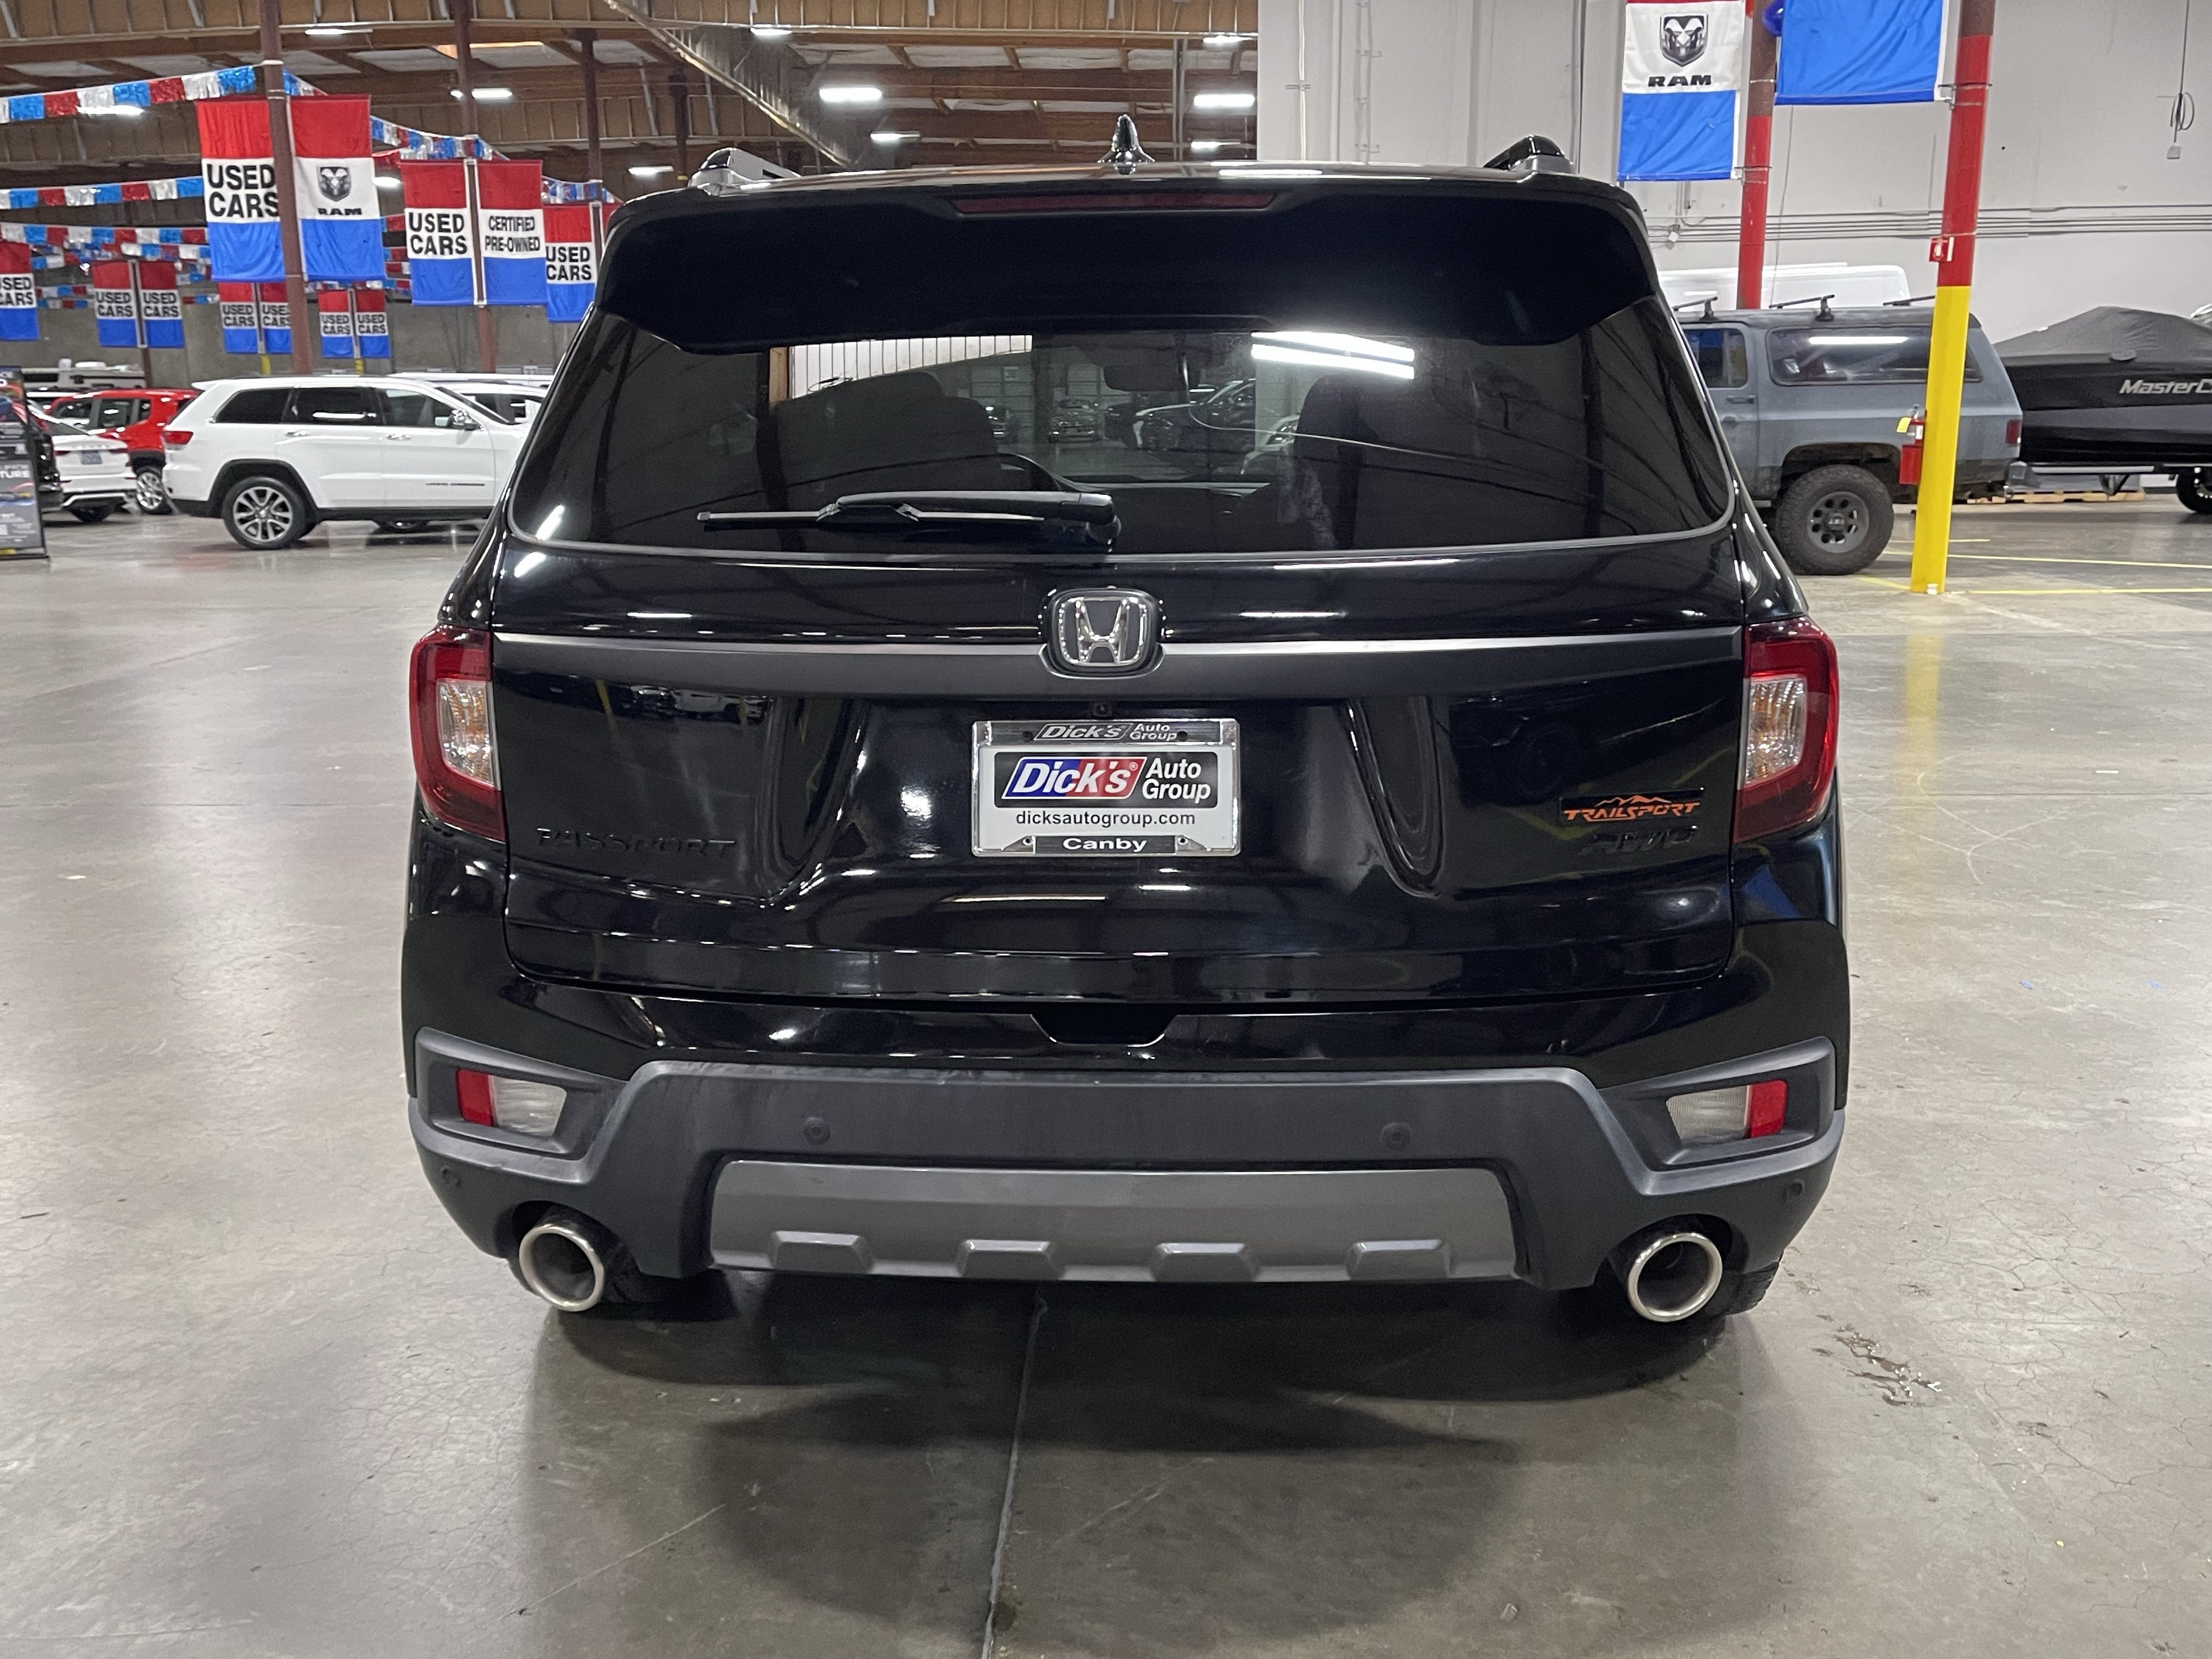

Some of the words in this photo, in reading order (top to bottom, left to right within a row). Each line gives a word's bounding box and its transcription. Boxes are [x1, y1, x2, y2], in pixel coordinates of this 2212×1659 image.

[1648, 75, 1711, 87] RAM
[207, 164, 275, 190] USED
[209, 191, 279, 218] CARS
[409, 212, 465, 233] USED
[489, 216, 535, 232] CERTIFIED
[410, 235, 467, 255] CARS
[485, 235, 540, 252] PRE-OWNED
[546, 246, 590, 262] USED
[546, 264, 591, 280] CARS
[0, 277, 32, 290] SED
[96, 291, 131, 303] USED
[143, 292, 178, 304] USED
[97, 305, 133, 317] CARS
[144, 305, 179, 317] CARS
[223, 304, 253, 315] USED
[224, 317, 255, 327] CARS
[322, 314, 349, 324] USED
[357, 314, 384, 324] USED
[323, 325, 351, 335] CARS
[358, 325, 386, 335] CARS
[1042, 725, 1122, 738] Dick's
[1133, 723, 1170, 732] Auto
[1130, 731, 1178, 741] Group
[1146, 758, 1202, 779] Auto
[1012, 760, 1131, 794] Dick's
[1142, 779, 1211, 804] Group
[1016, 810, 1195, 827] dicksautogroup.com
[1564, 802, 1700, 822] TRAILSPORT
[1063, 838, 1148, 851] Canby
